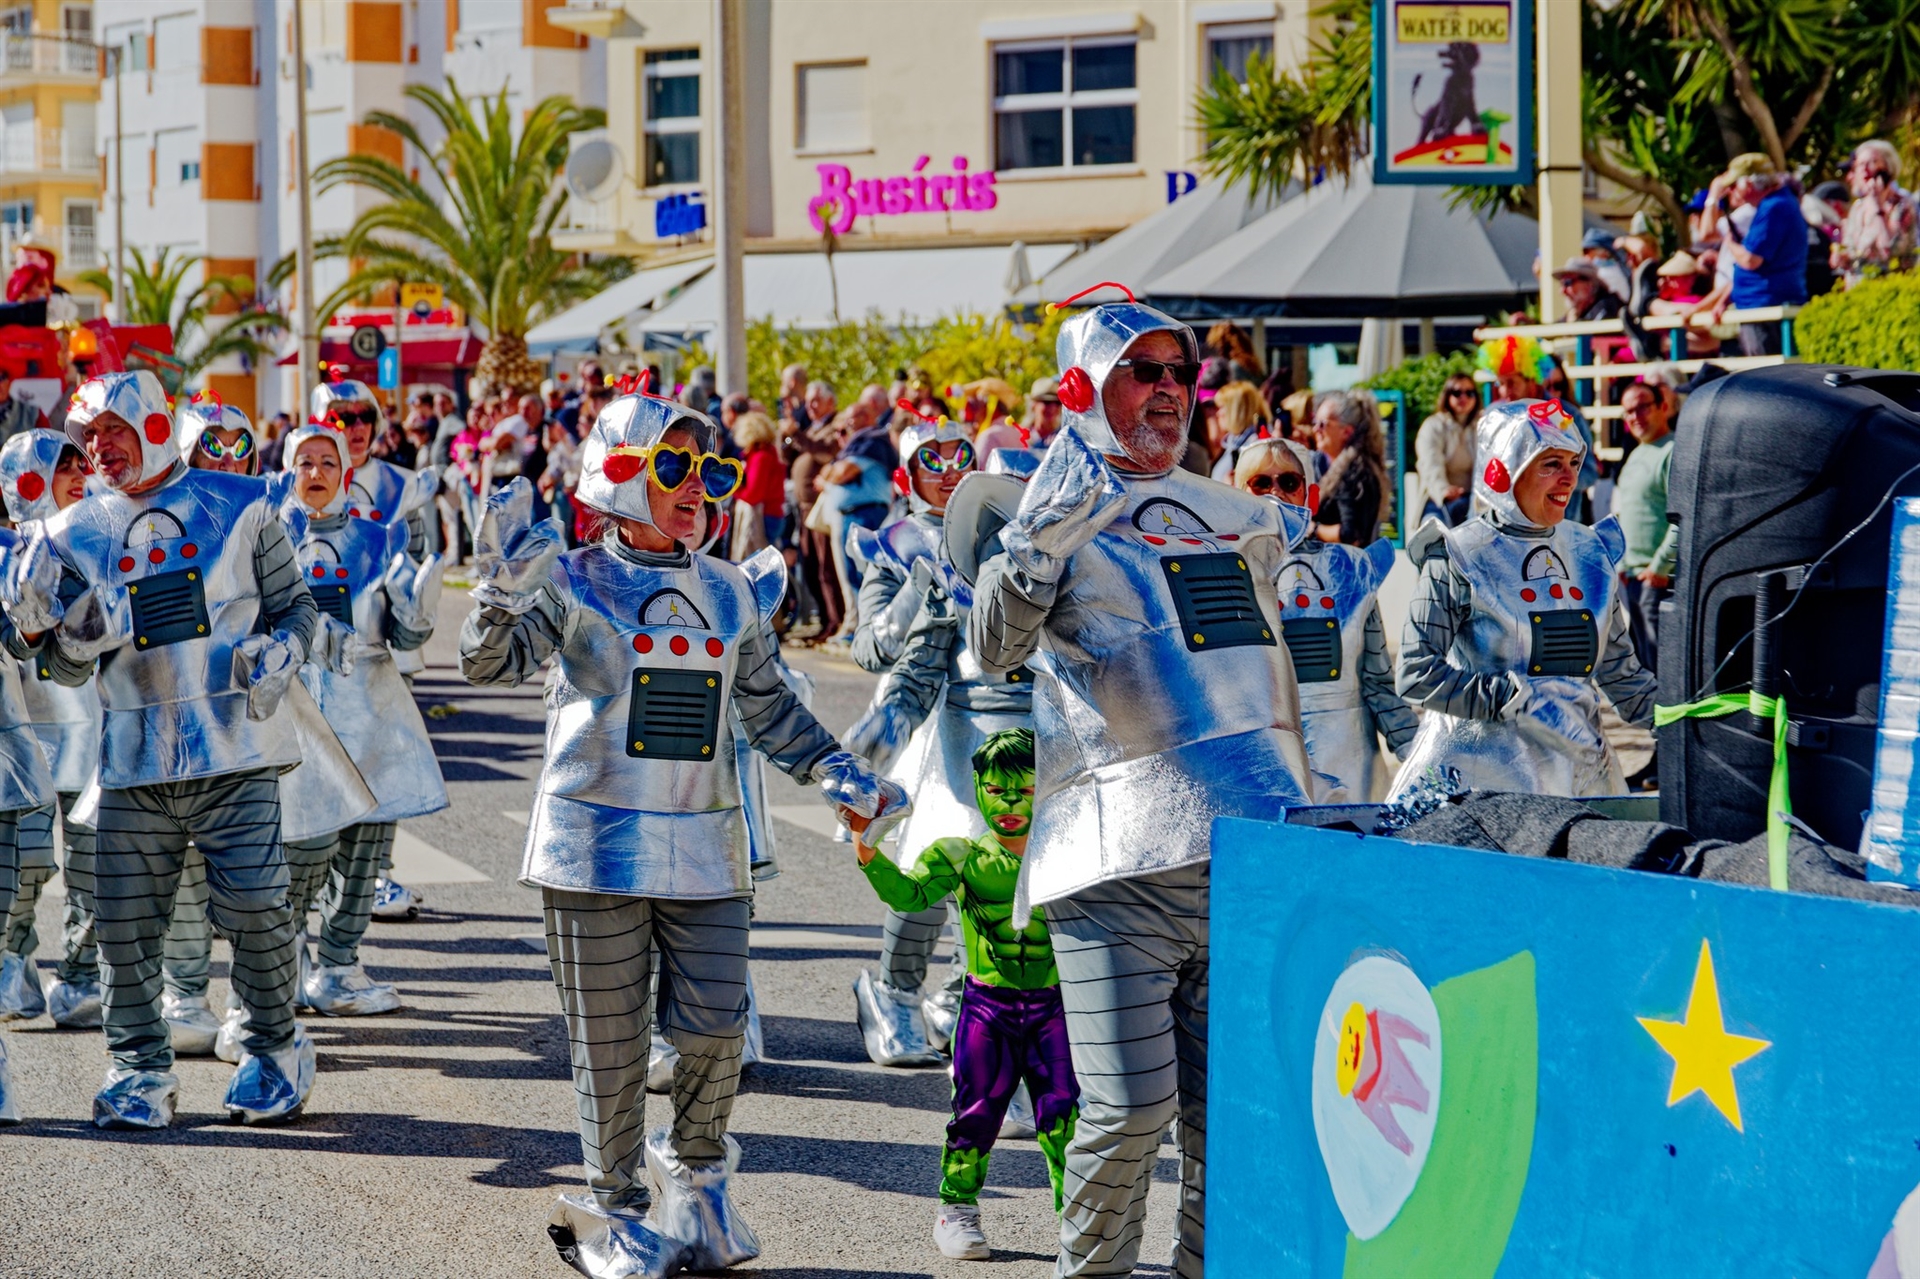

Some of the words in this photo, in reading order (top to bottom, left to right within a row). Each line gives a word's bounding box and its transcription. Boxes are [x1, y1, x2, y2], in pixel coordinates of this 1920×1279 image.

[1403, 18, 1463, 37] WATER
[1468, 18, 1505, 37] DOG
[808, 154, 998, 235] Busíris
